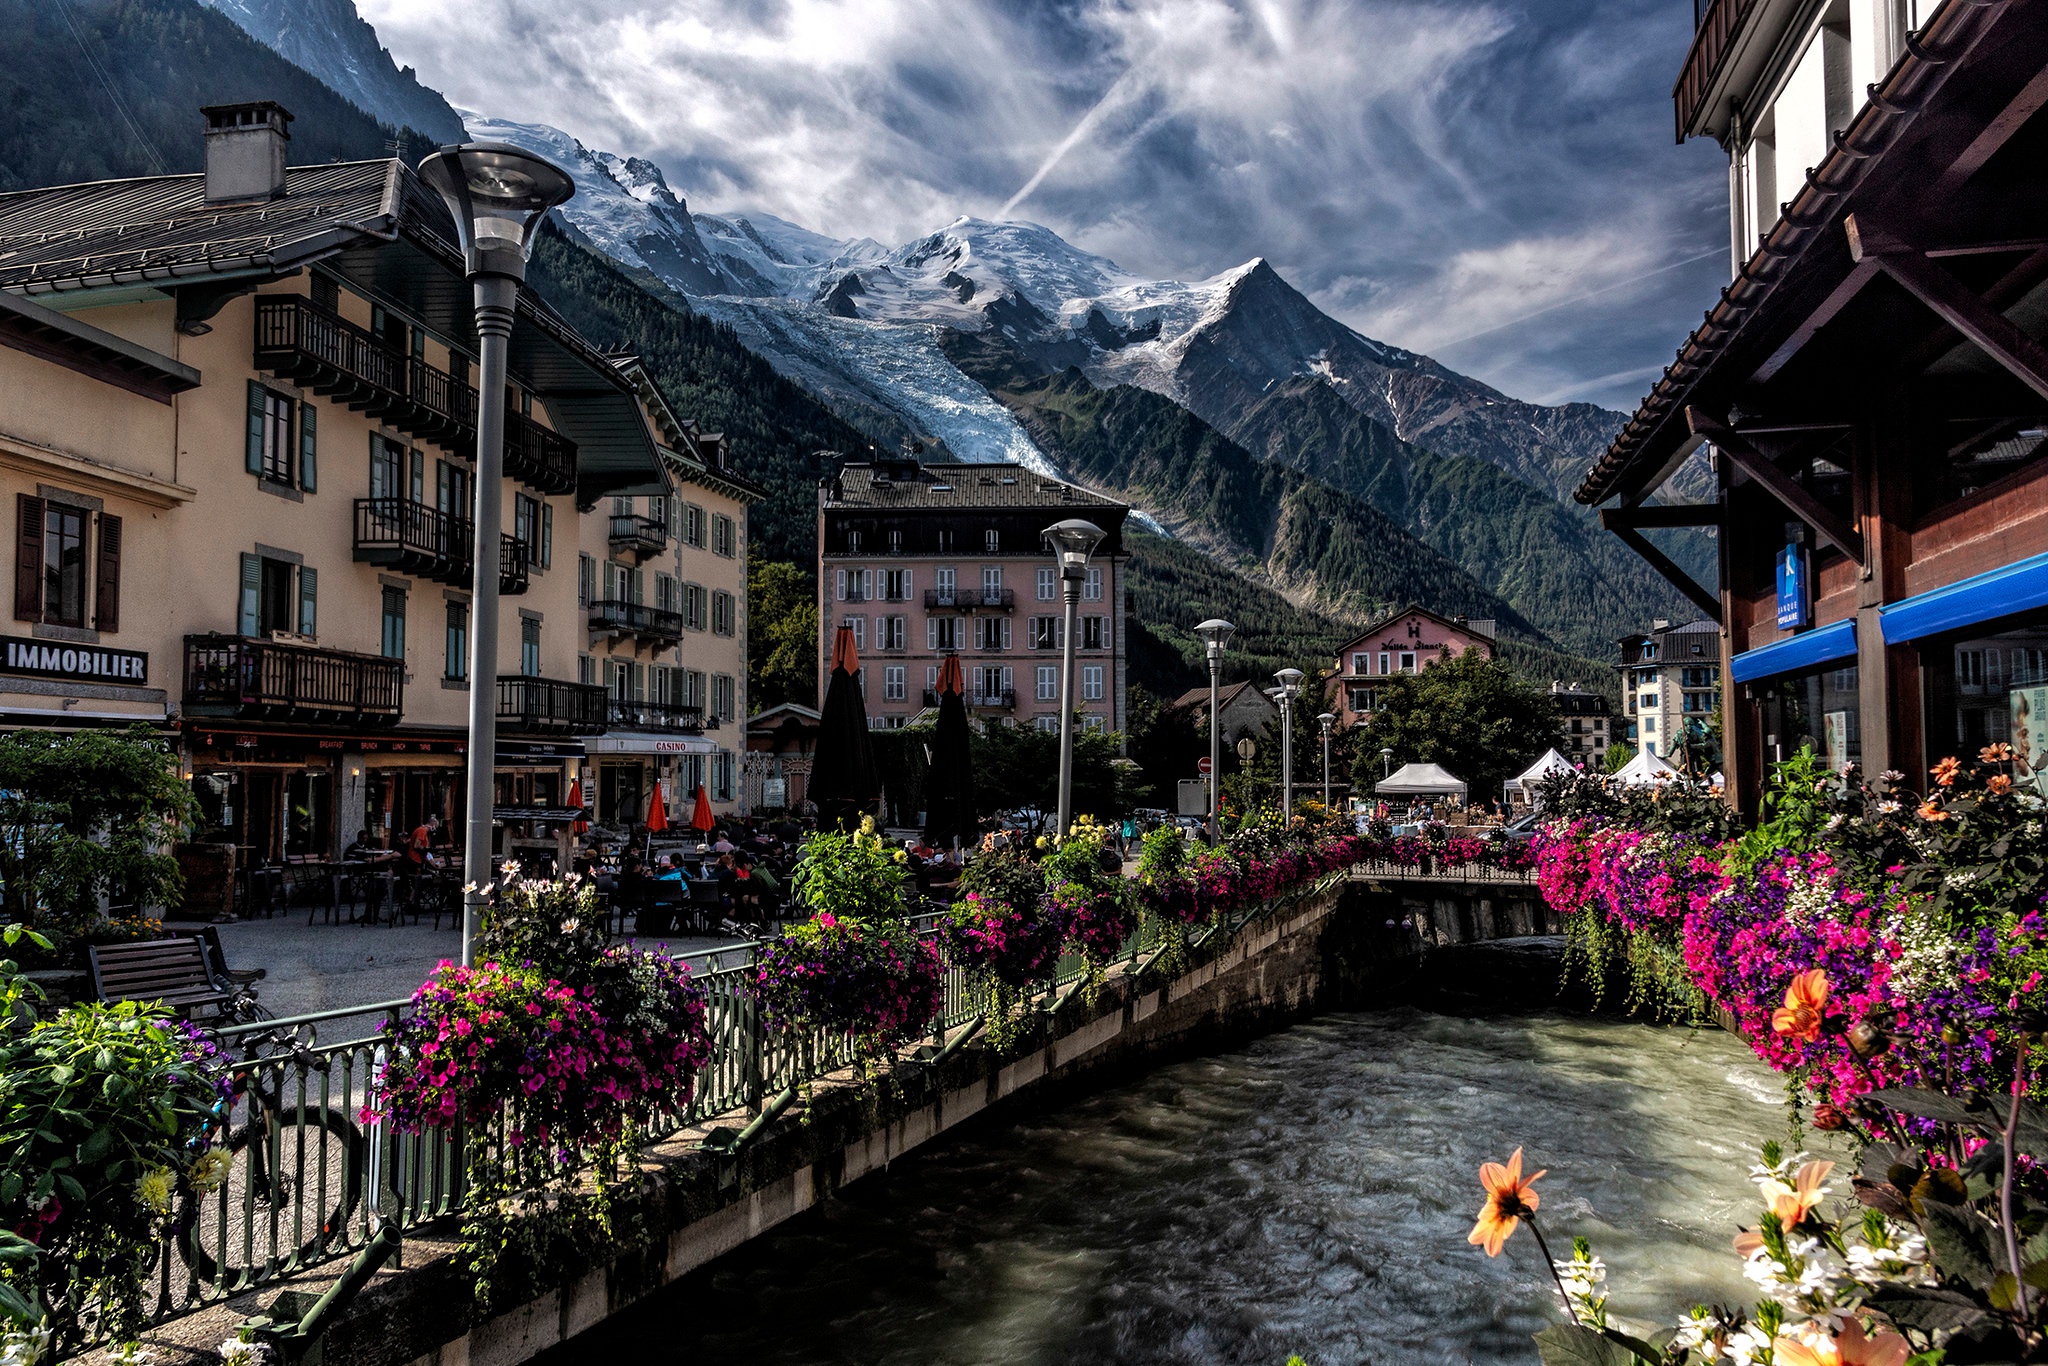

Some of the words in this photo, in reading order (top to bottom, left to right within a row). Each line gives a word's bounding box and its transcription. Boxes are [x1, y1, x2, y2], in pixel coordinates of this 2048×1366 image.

[7, 643, 145, 679] IMMOBILIER
[319, 740, 345, 750] BREAKFAST
[360, 741, 378, 750] BRUNCH
[656, 742, 686, 752] CASINO
